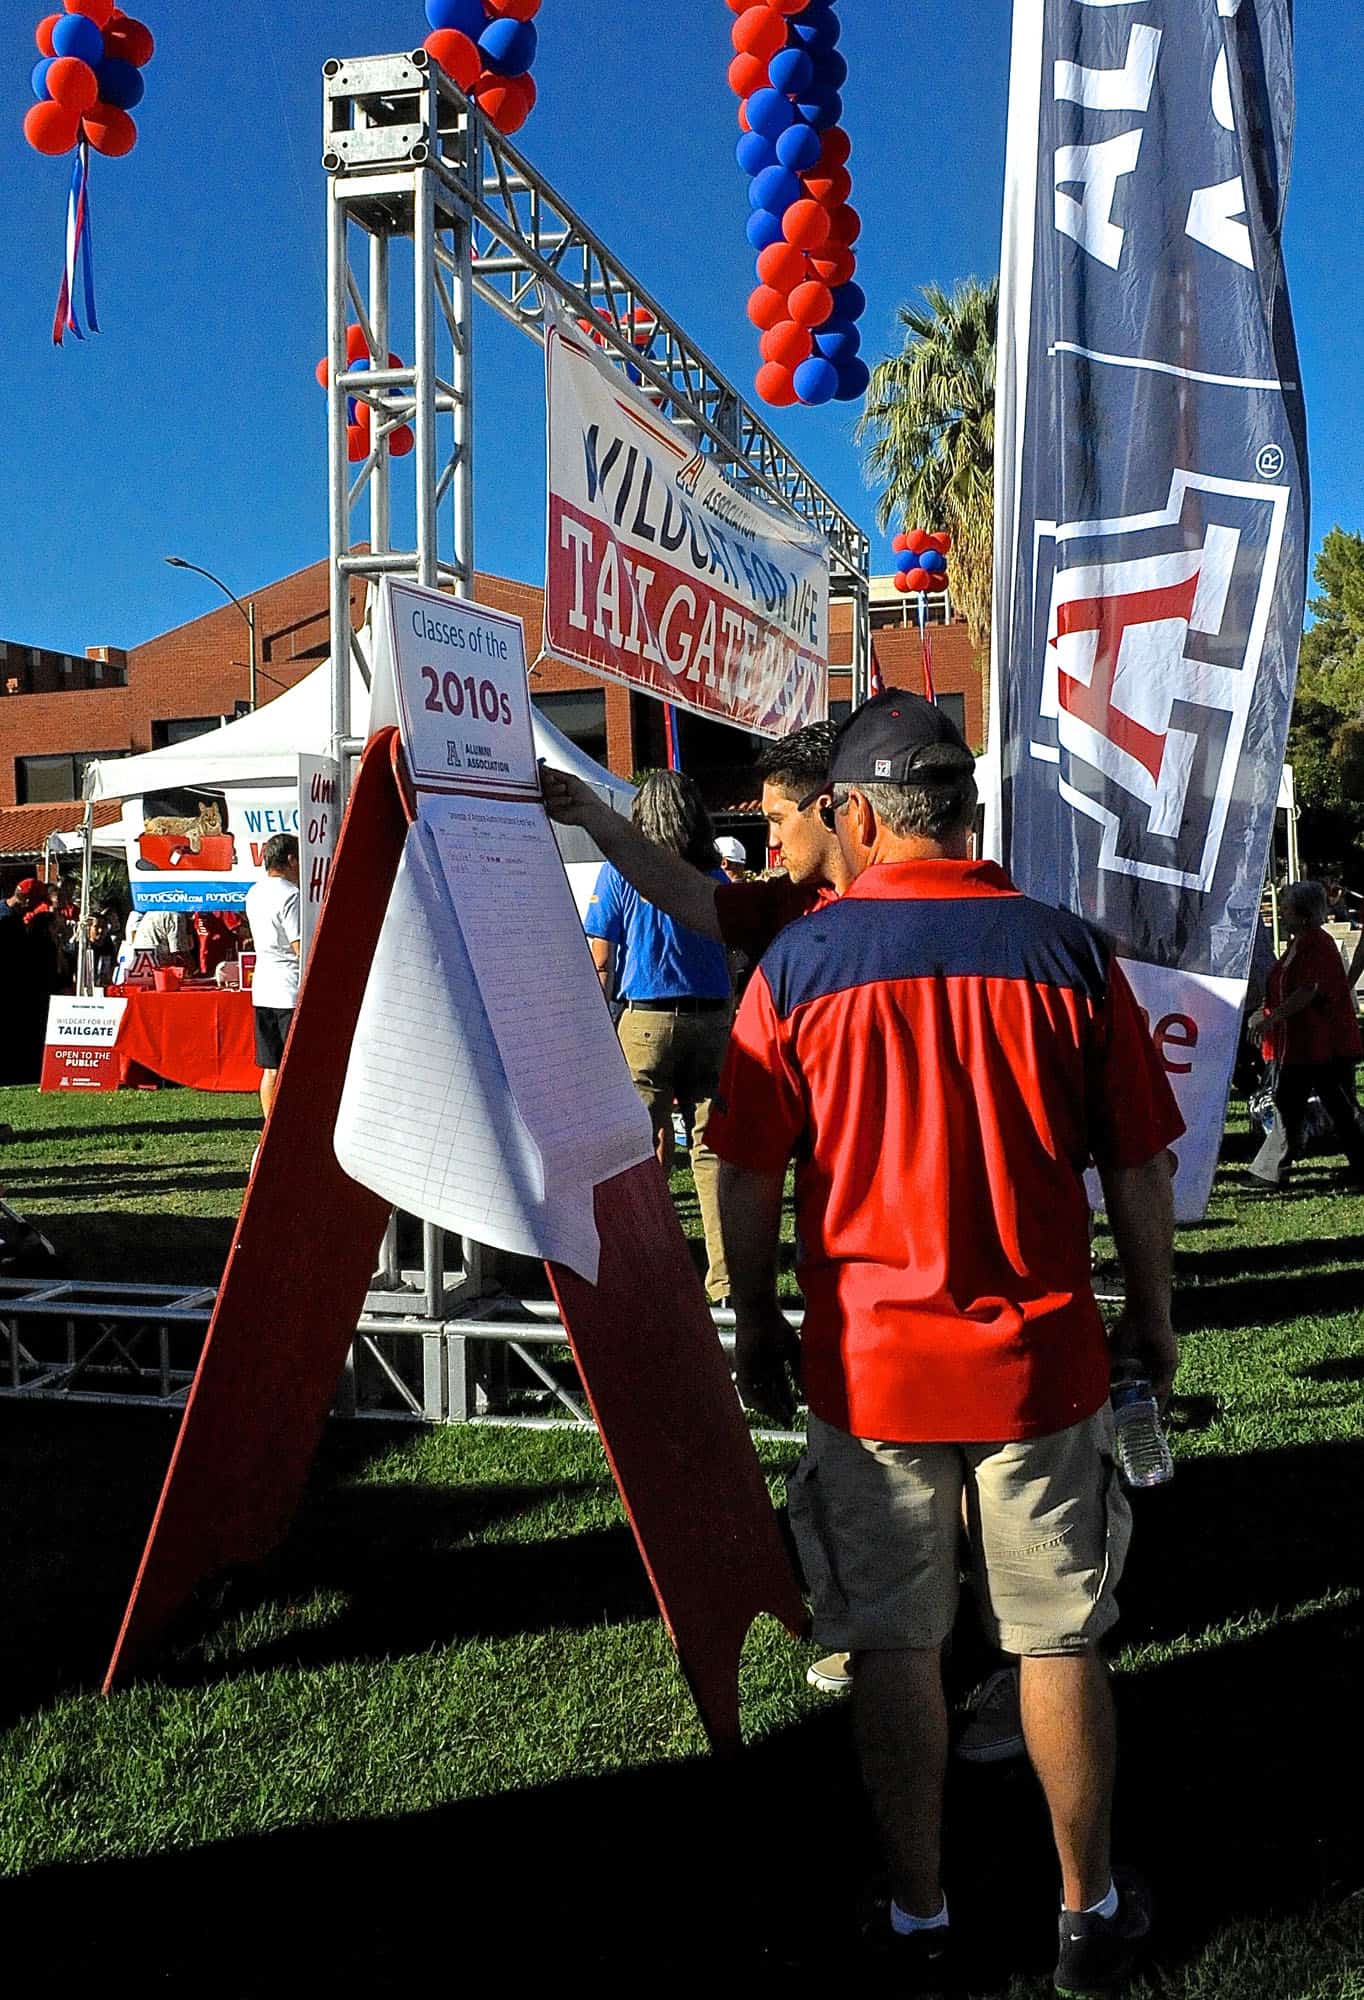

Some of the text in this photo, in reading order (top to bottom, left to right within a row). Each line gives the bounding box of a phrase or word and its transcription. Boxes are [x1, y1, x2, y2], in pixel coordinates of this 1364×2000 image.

[734, 541, 789, 622] FOR
[789, 572, 819, 646] LIFE
[412, 610, 508, 660] Classes of the
[421, 665, 512, 726] 2010s
[466, 743, 492, 757] ALUMNI
[467, 758, 510, 773] ASSOCIATION
[308, 813, 327, 844] of
[57, 1018, 116, 1027] WILDCAT FOR LIFE
[58, 1026, 114, 1036] TAILGATE
[55, 1050, 111, 1060] OPEN TO THE
[65, 1059, 100, 1068] PUBLIC
